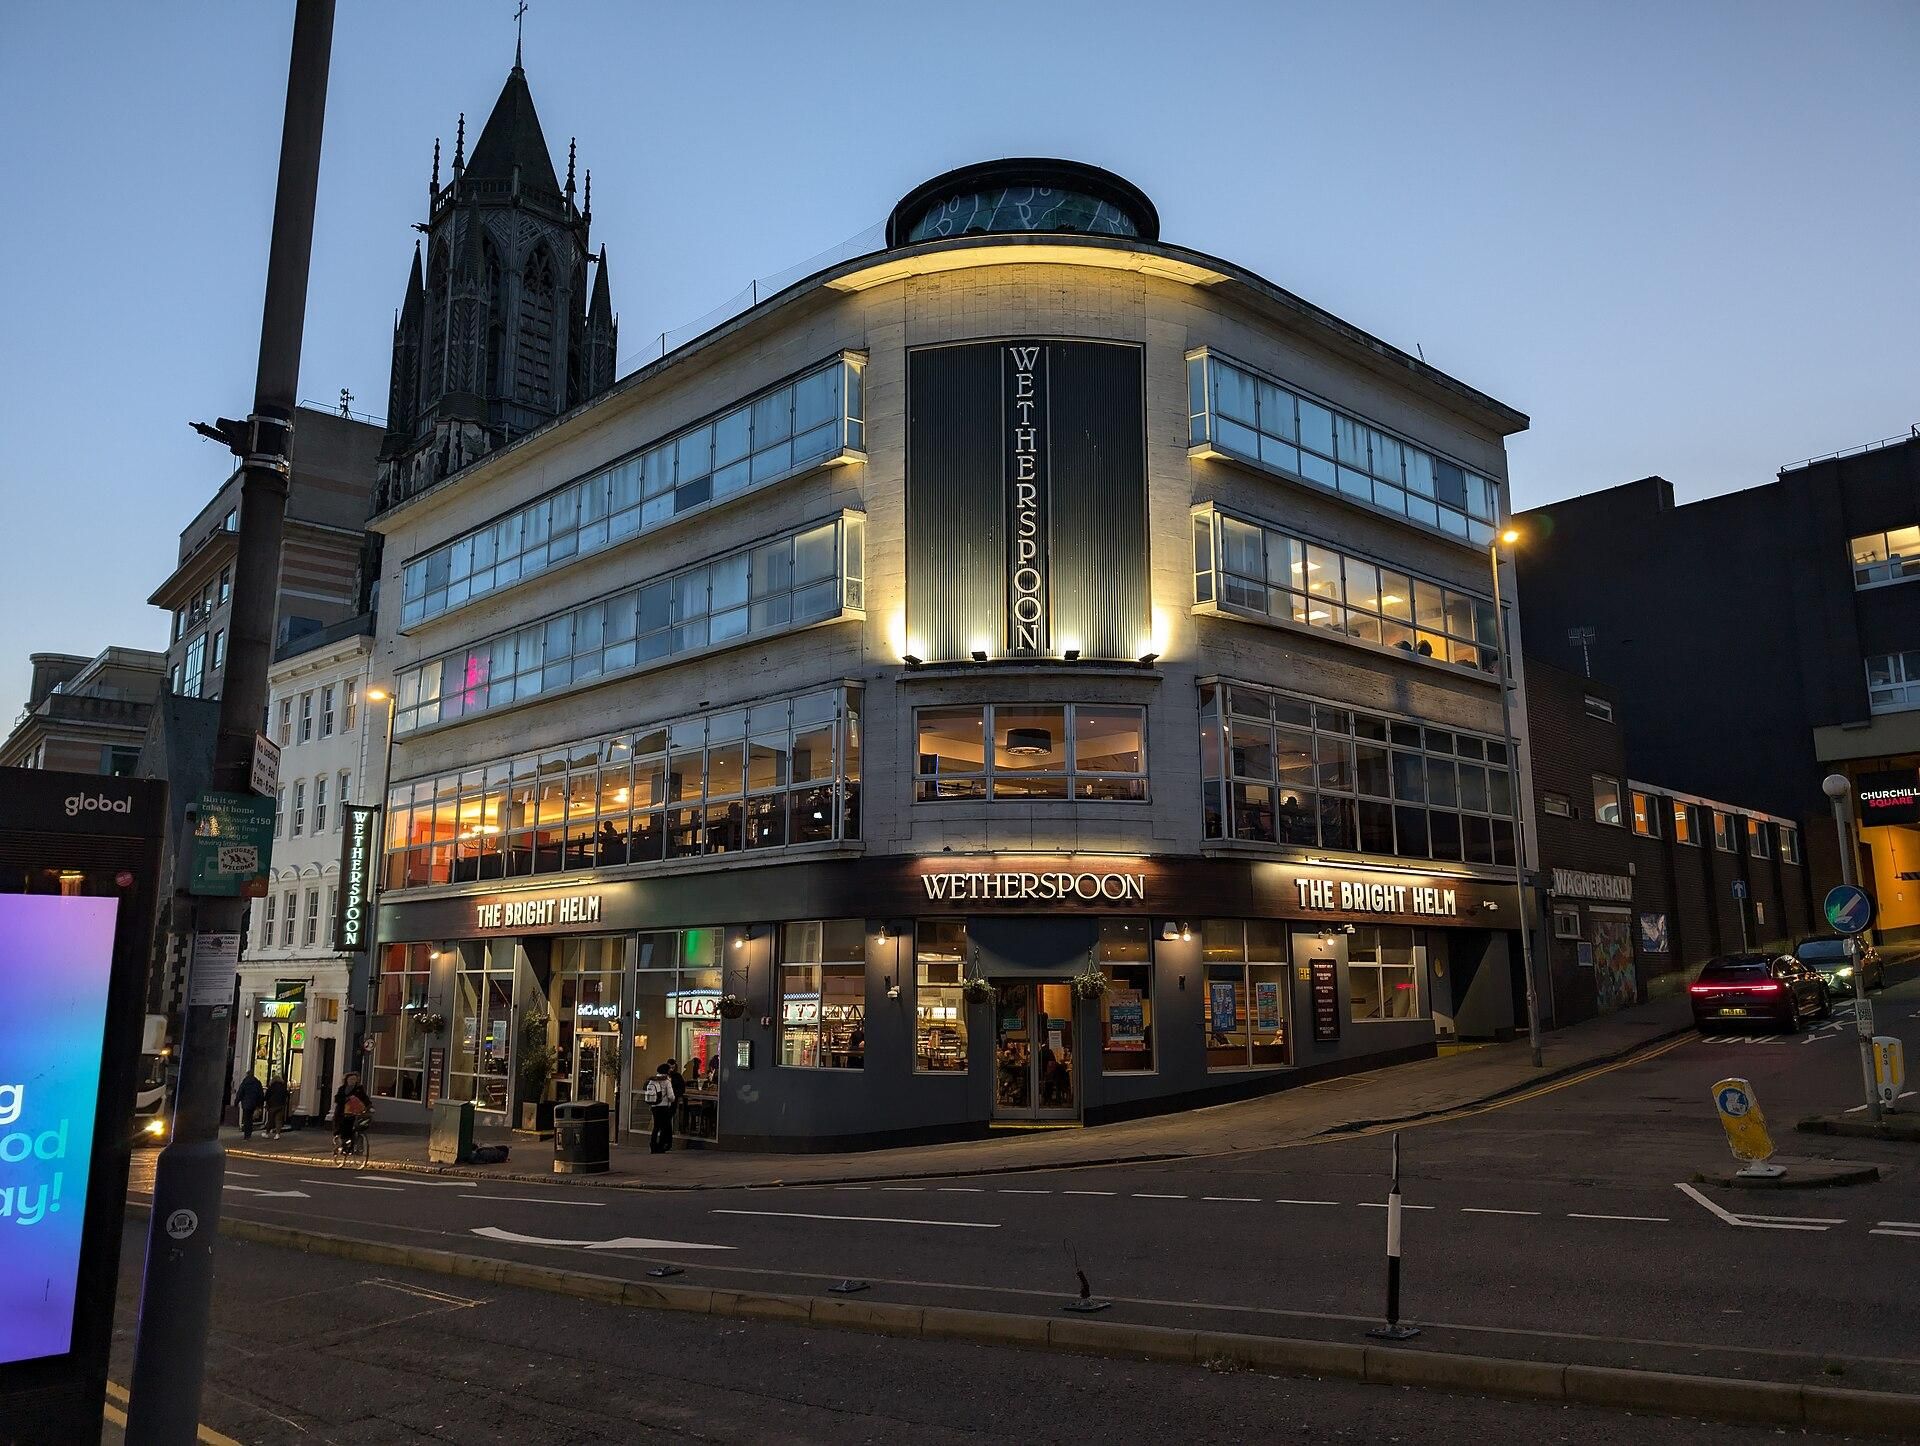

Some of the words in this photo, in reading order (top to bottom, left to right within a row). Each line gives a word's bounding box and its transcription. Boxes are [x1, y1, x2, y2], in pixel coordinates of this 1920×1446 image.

[1009, 346, 1043, 650] WETHERSPOON
[263, 744, 279, 766] loading
[64, 791, 132, 816] global
[203, 795, 219, 803] Bin
[1860, 788, 1920, 800] CHURCHILL
[1869, 796, 1914, 807] SQUARE
[230, 805, 255, 814] home
[249, 817, 271, 825] £150
[222, 846, 255, 857] REFUGEES
[222, 862, 255, 872] WELCOME
[345, 811, 368, 945] WETHERSPOON
[921, 872, 1145, 900] WETHERSPOON
[1555, 870, 1604, 897] WAGNER
[1603, 876, 1632, 900] HALL
[1295, 878, 1335, 910] THE
[1340, 881, 1407, 914] BRIGHT
[1411, 886, 1457, 916] HELM
[476, 903, 502, 929] THE
[505, 898, 557, 927] BRIGHT
[559, 895, 601, 923] HELM
[277, 985, 305, 1000] SUBWAY
[262, 1002, 296, 1019] SUBWAY
[0, 1084, 24, 1125] g
[0, 1118, 69, 1163] od
